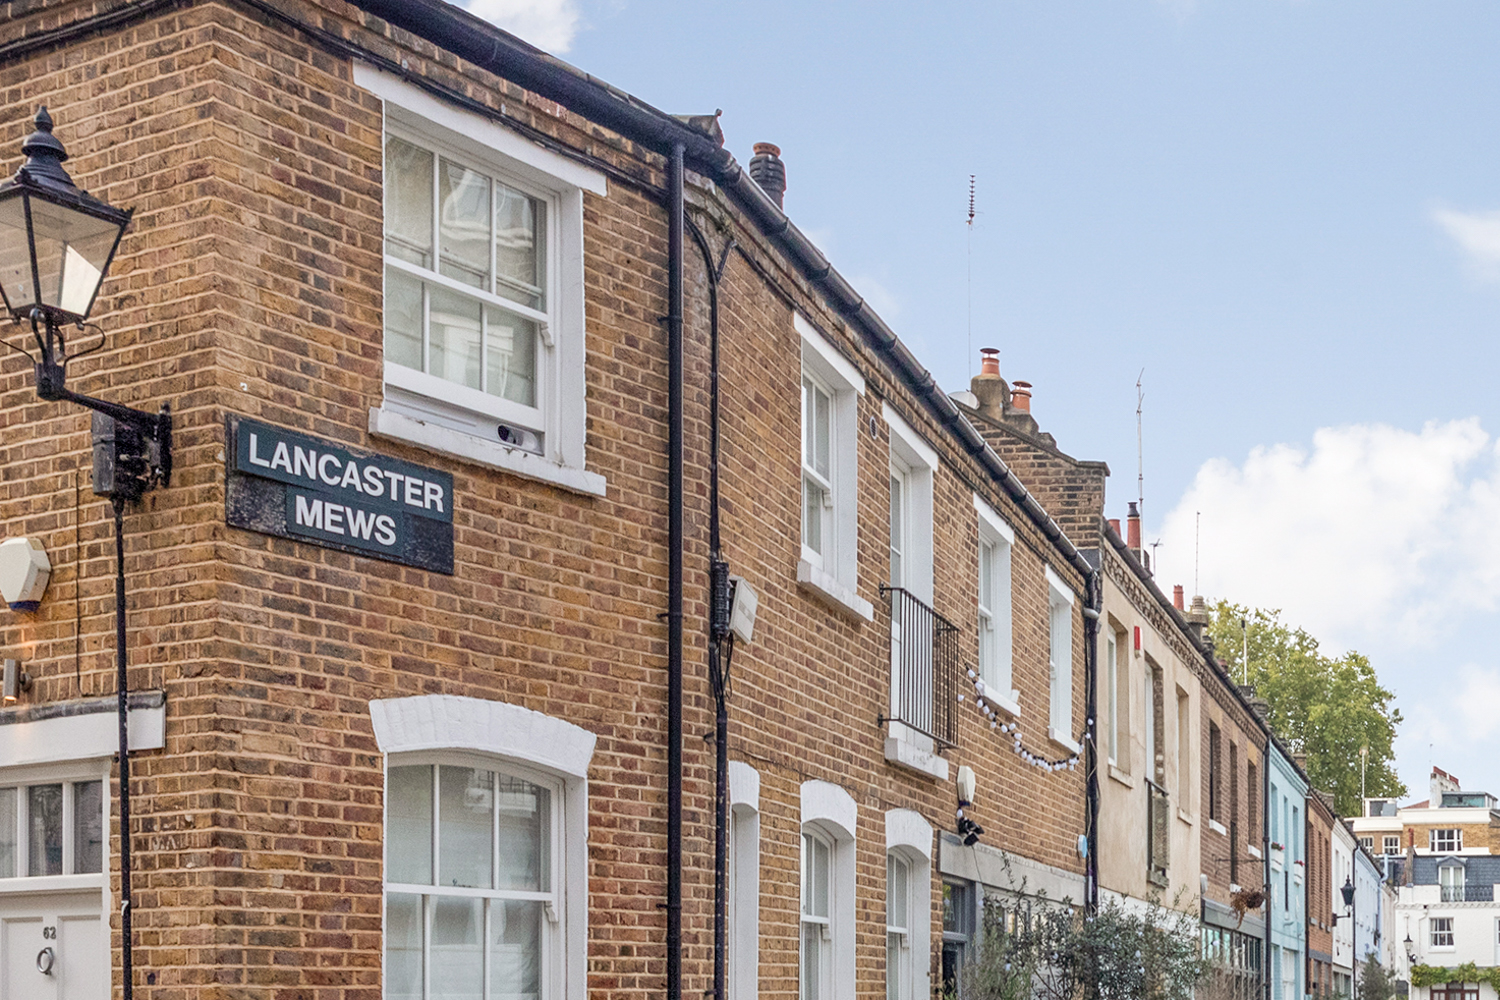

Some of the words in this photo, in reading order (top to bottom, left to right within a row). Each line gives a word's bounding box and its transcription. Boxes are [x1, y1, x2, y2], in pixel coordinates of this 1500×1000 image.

[249, 433, 444, 512] LANCASTER
[295, 494, 397, 546] MEWS
[43, 926, 56, 939] 62
